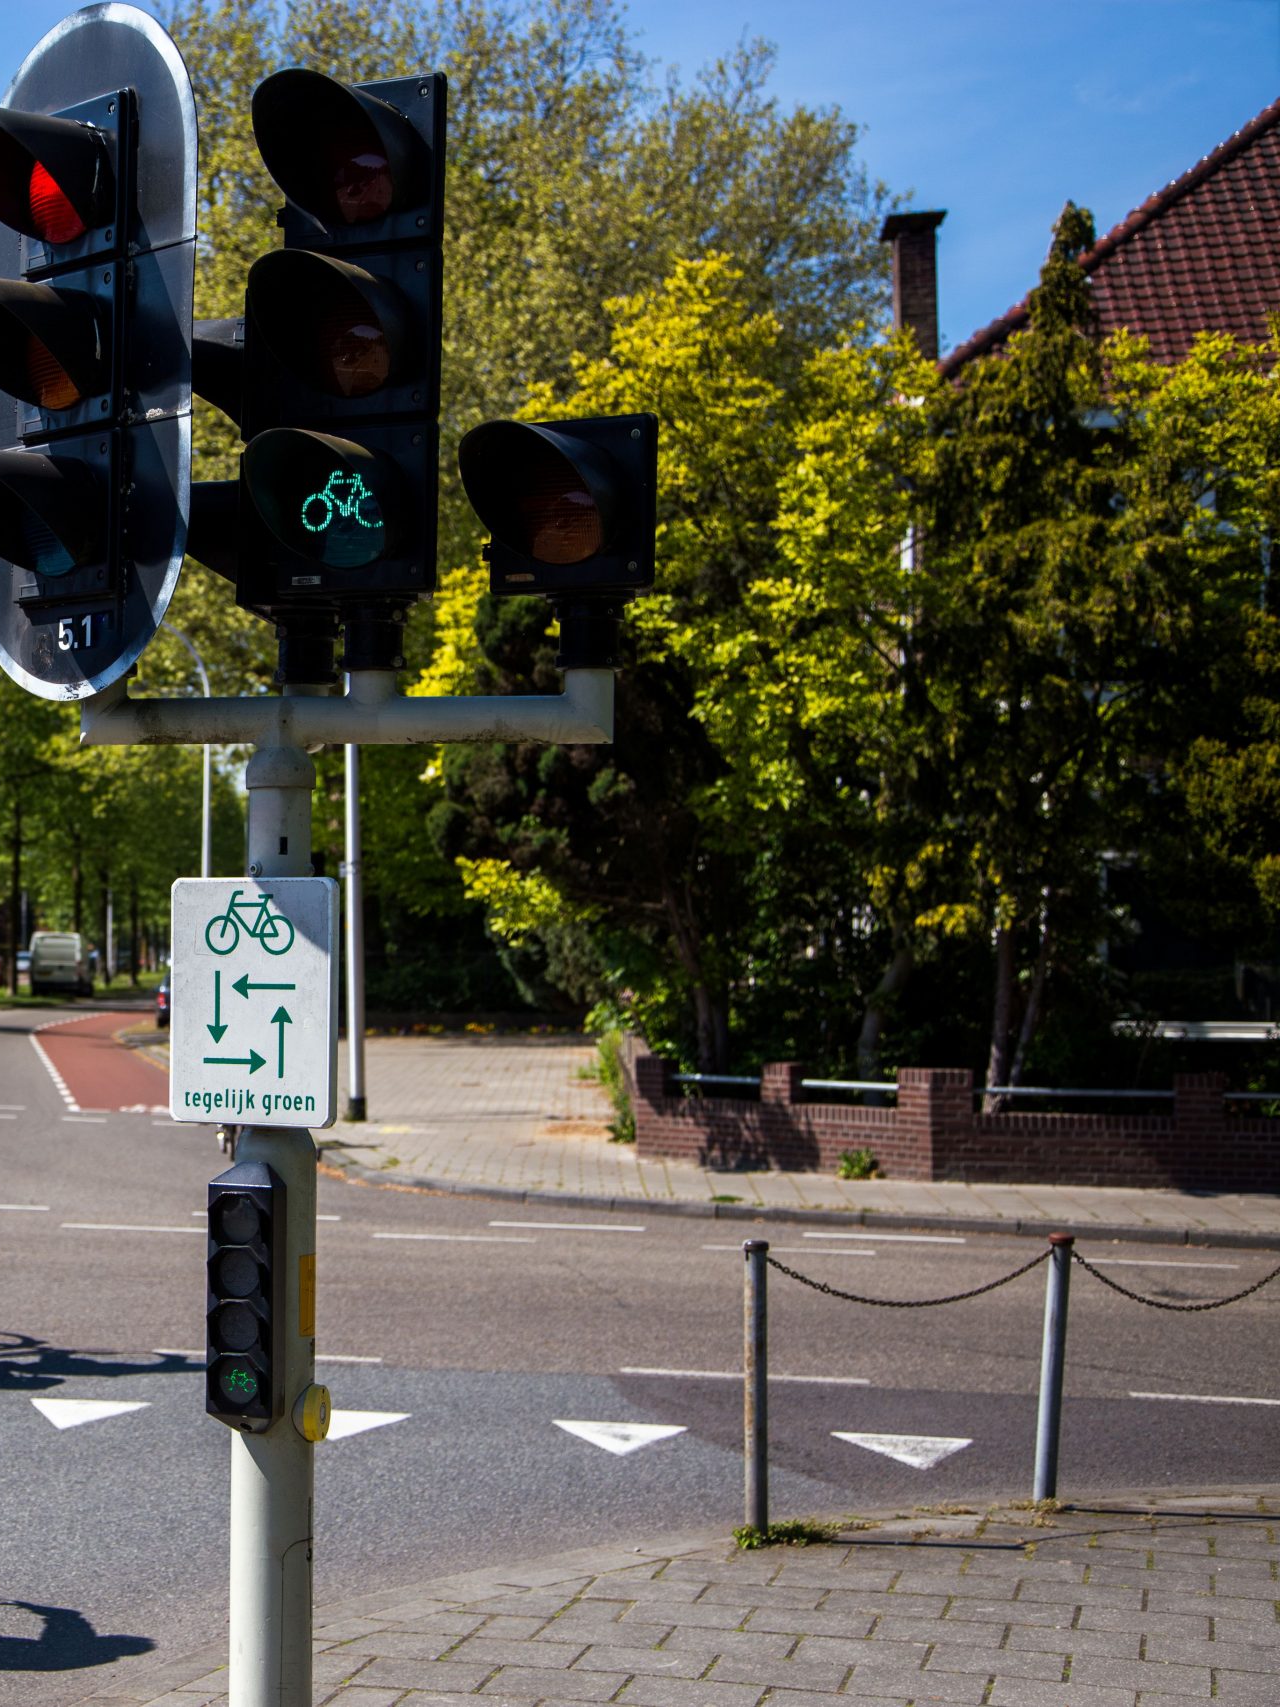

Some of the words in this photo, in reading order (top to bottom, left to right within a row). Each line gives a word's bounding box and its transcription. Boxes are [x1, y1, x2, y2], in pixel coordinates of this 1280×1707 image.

[57, 614, 92, 651] 5.1
[184, 1088, 255, 1115] tegelijk
[262, 1094, 315, 1116] groen
